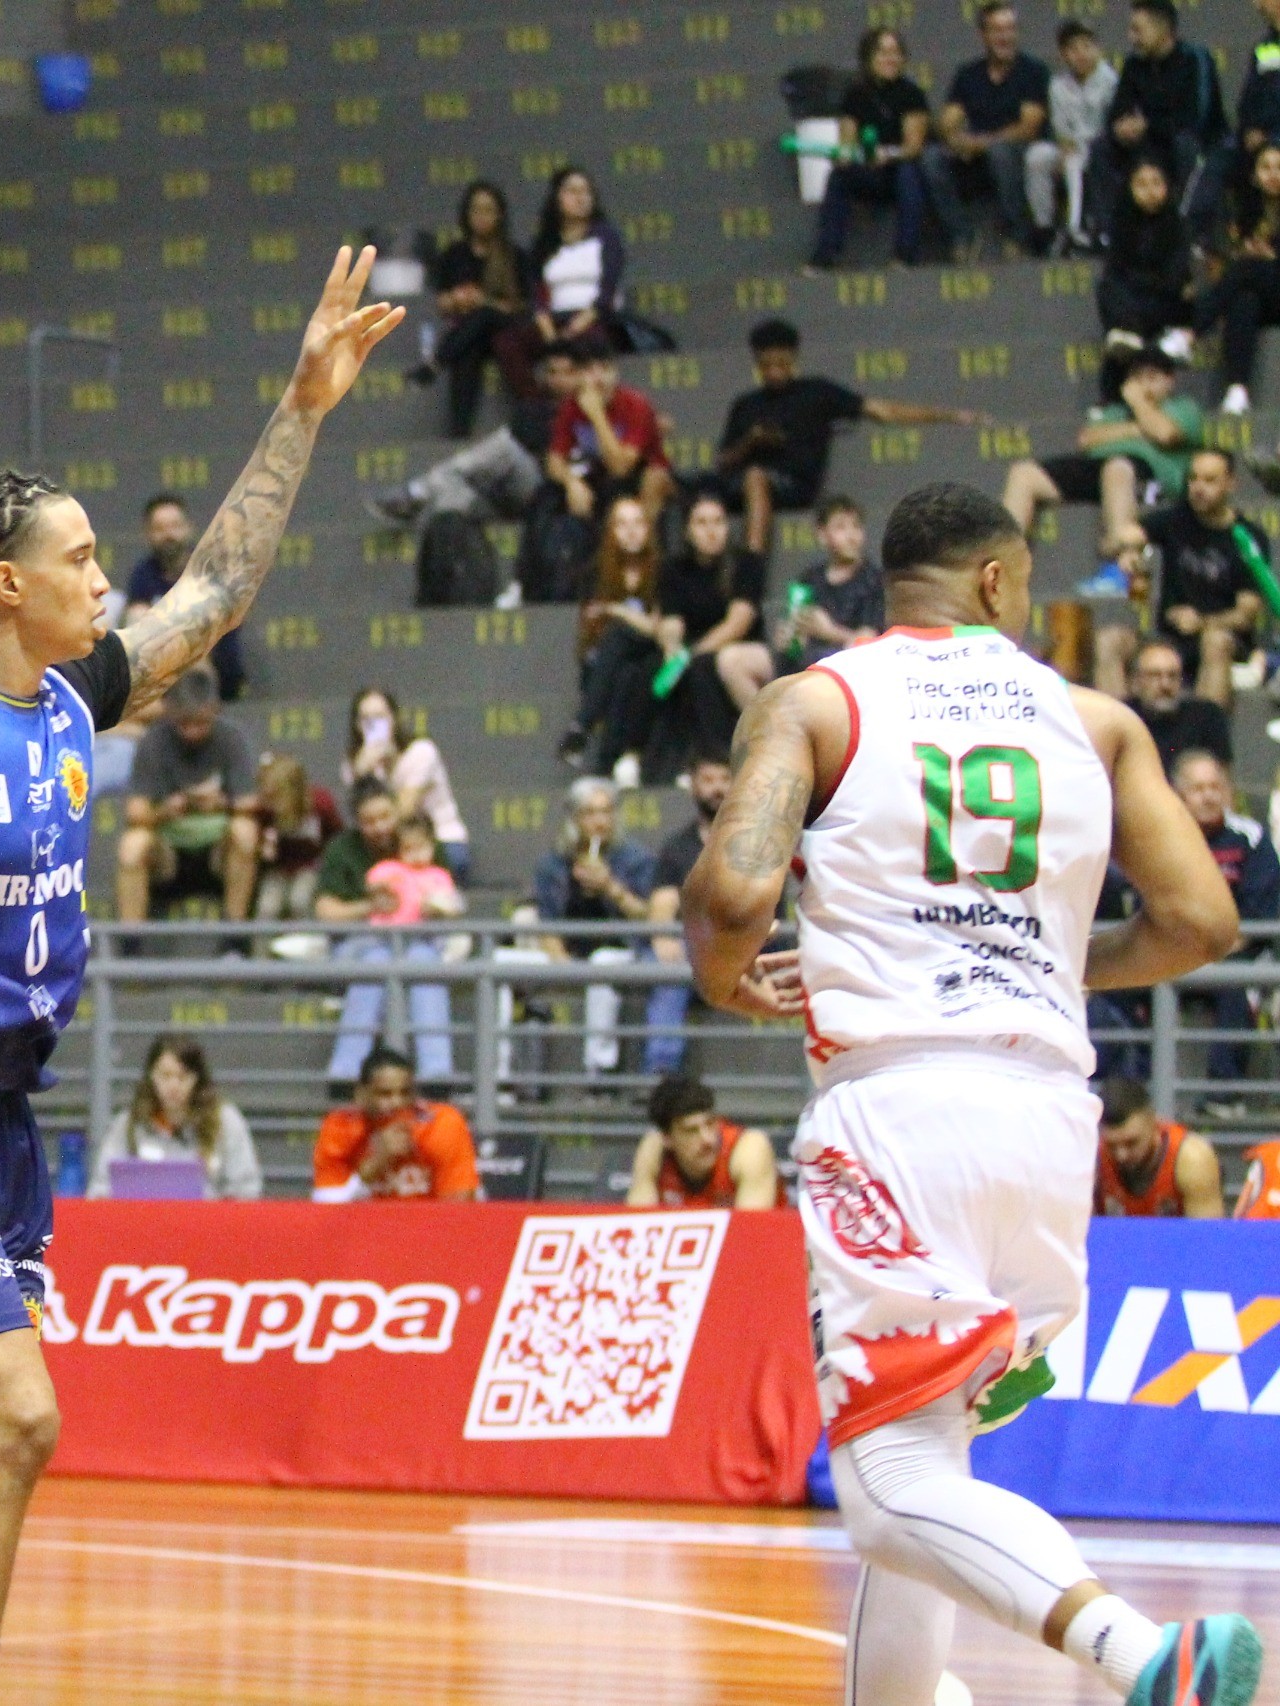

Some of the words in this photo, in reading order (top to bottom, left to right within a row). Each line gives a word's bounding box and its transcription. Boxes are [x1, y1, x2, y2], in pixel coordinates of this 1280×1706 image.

[911, 741, 1043, 894] 19
[25, 910, 50, 977] 0
[84, 1265, 460, 1363] Kappa
